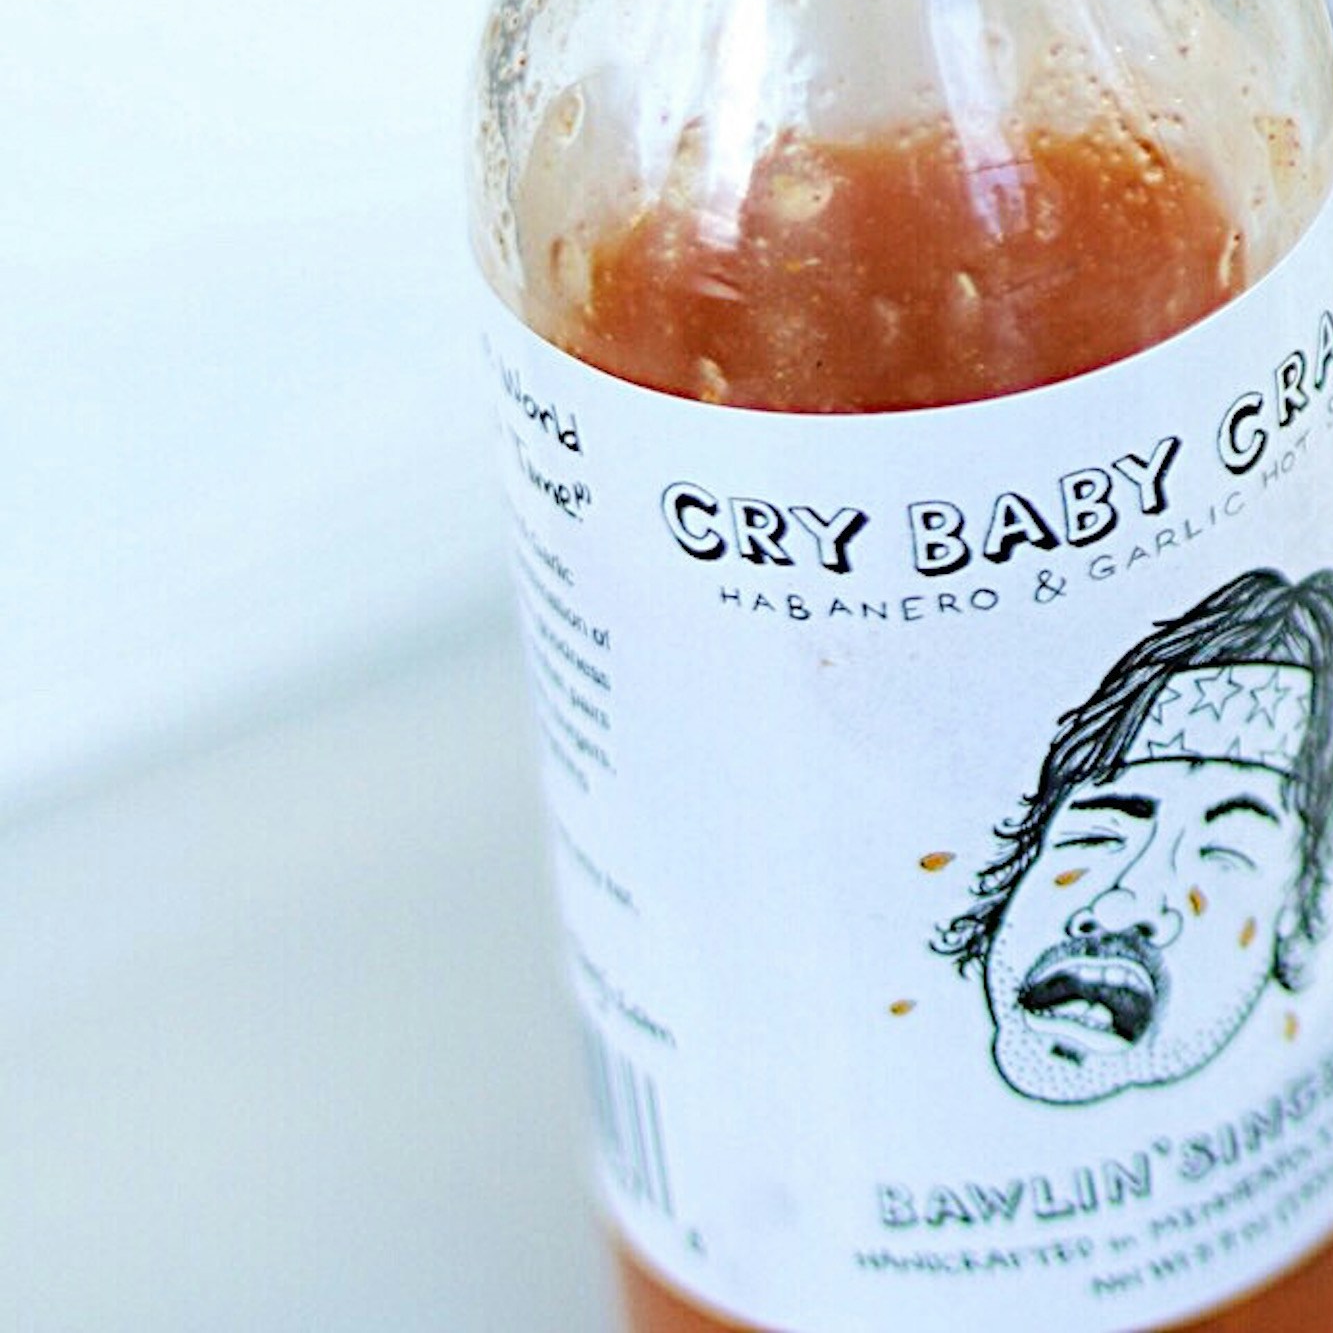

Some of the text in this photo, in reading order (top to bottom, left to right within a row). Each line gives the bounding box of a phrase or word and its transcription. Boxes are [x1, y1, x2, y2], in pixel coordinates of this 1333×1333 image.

[661, 480, 871, 575] CRY
[907, 435, 1183, 577] BABY
[721, 586, 999, 620] HABANERO
[1034, 568, 1068, 604] &
[1088, 491, 1247, 581] GARLIC
[1262, 432, 1311, 489] HOT
